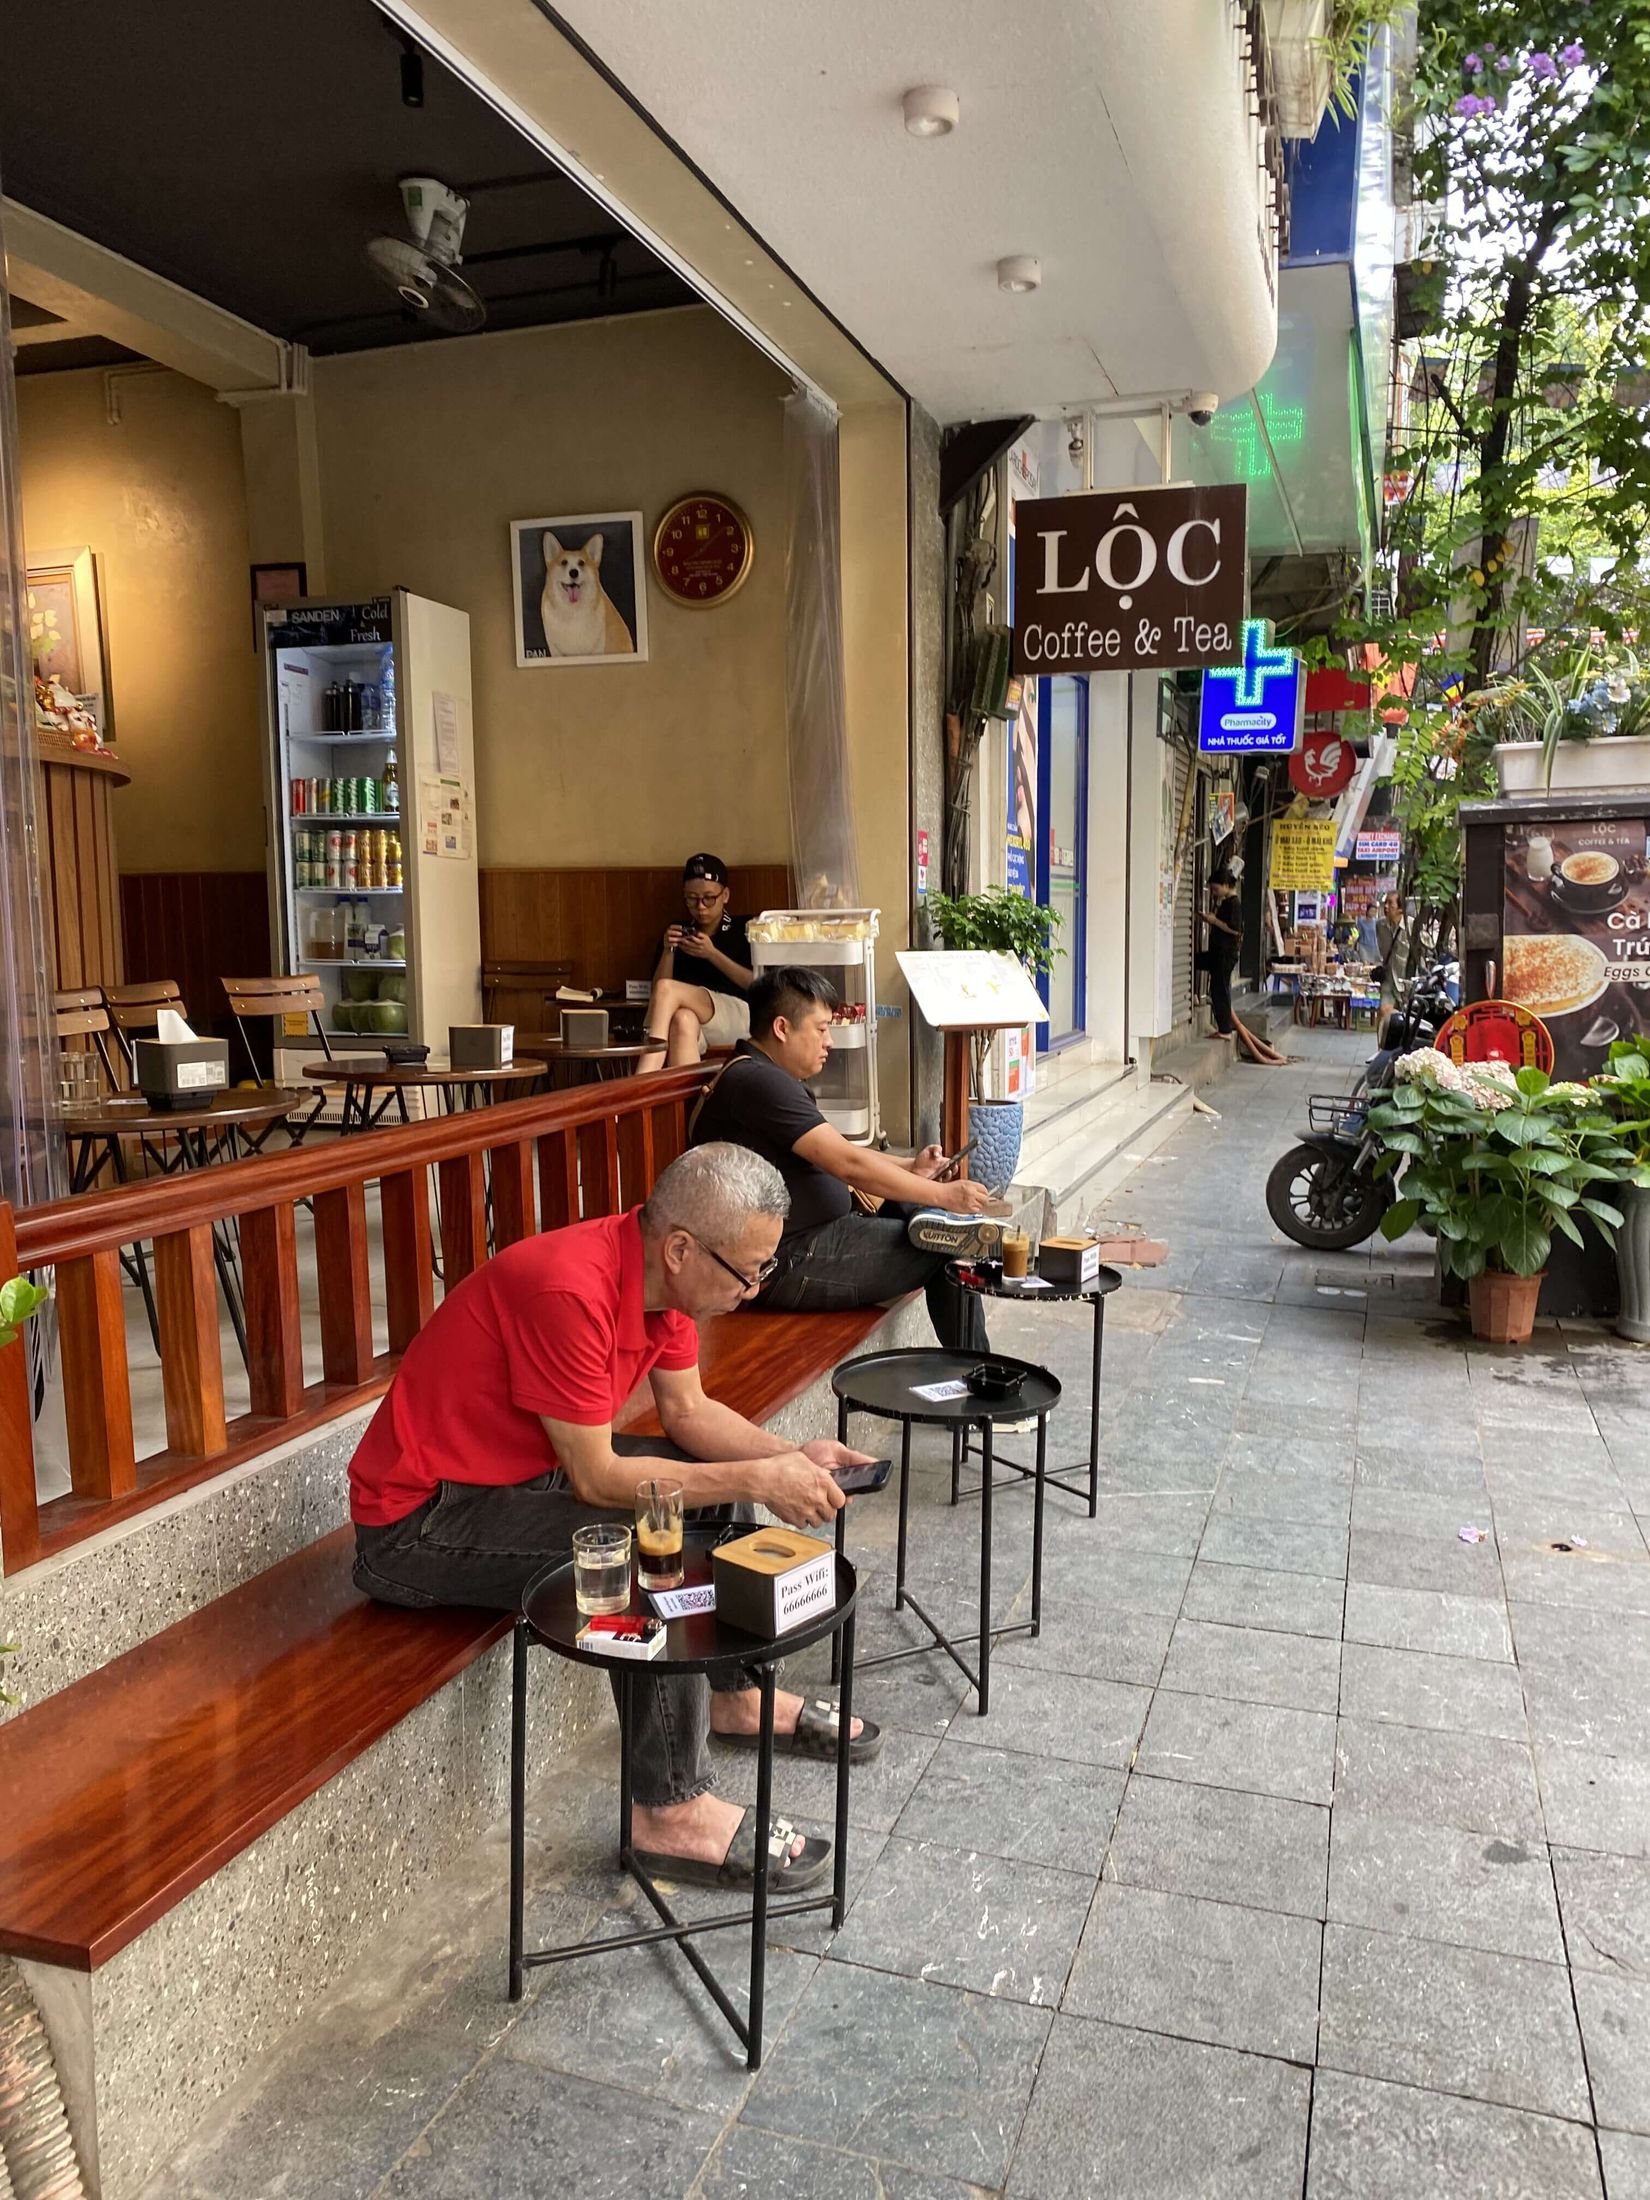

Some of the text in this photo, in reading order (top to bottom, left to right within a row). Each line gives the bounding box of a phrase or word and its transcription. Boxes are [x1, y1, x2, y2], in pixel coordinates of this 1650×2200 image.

[1036, 503, 1222, 611] LỘC
[291, 603, 388, 623] SANDEN Cold
[350, 626, 381, 642] Fresh
[1024, 616, 1233, 661] Coffee & Tea
[1224, 715, 1272, 727] Pharmacity
[1271, 732, 1287, 745] TỐT
[1592, 821, 1616, 836] LỘC
[1607, 911, 1640, 930] Cà
[1604, 966, 1640, 980] Eggs
[781, 1567, 829, 1599] Pass Wifi:
[783, 1584, 828, 1615] 66666666
